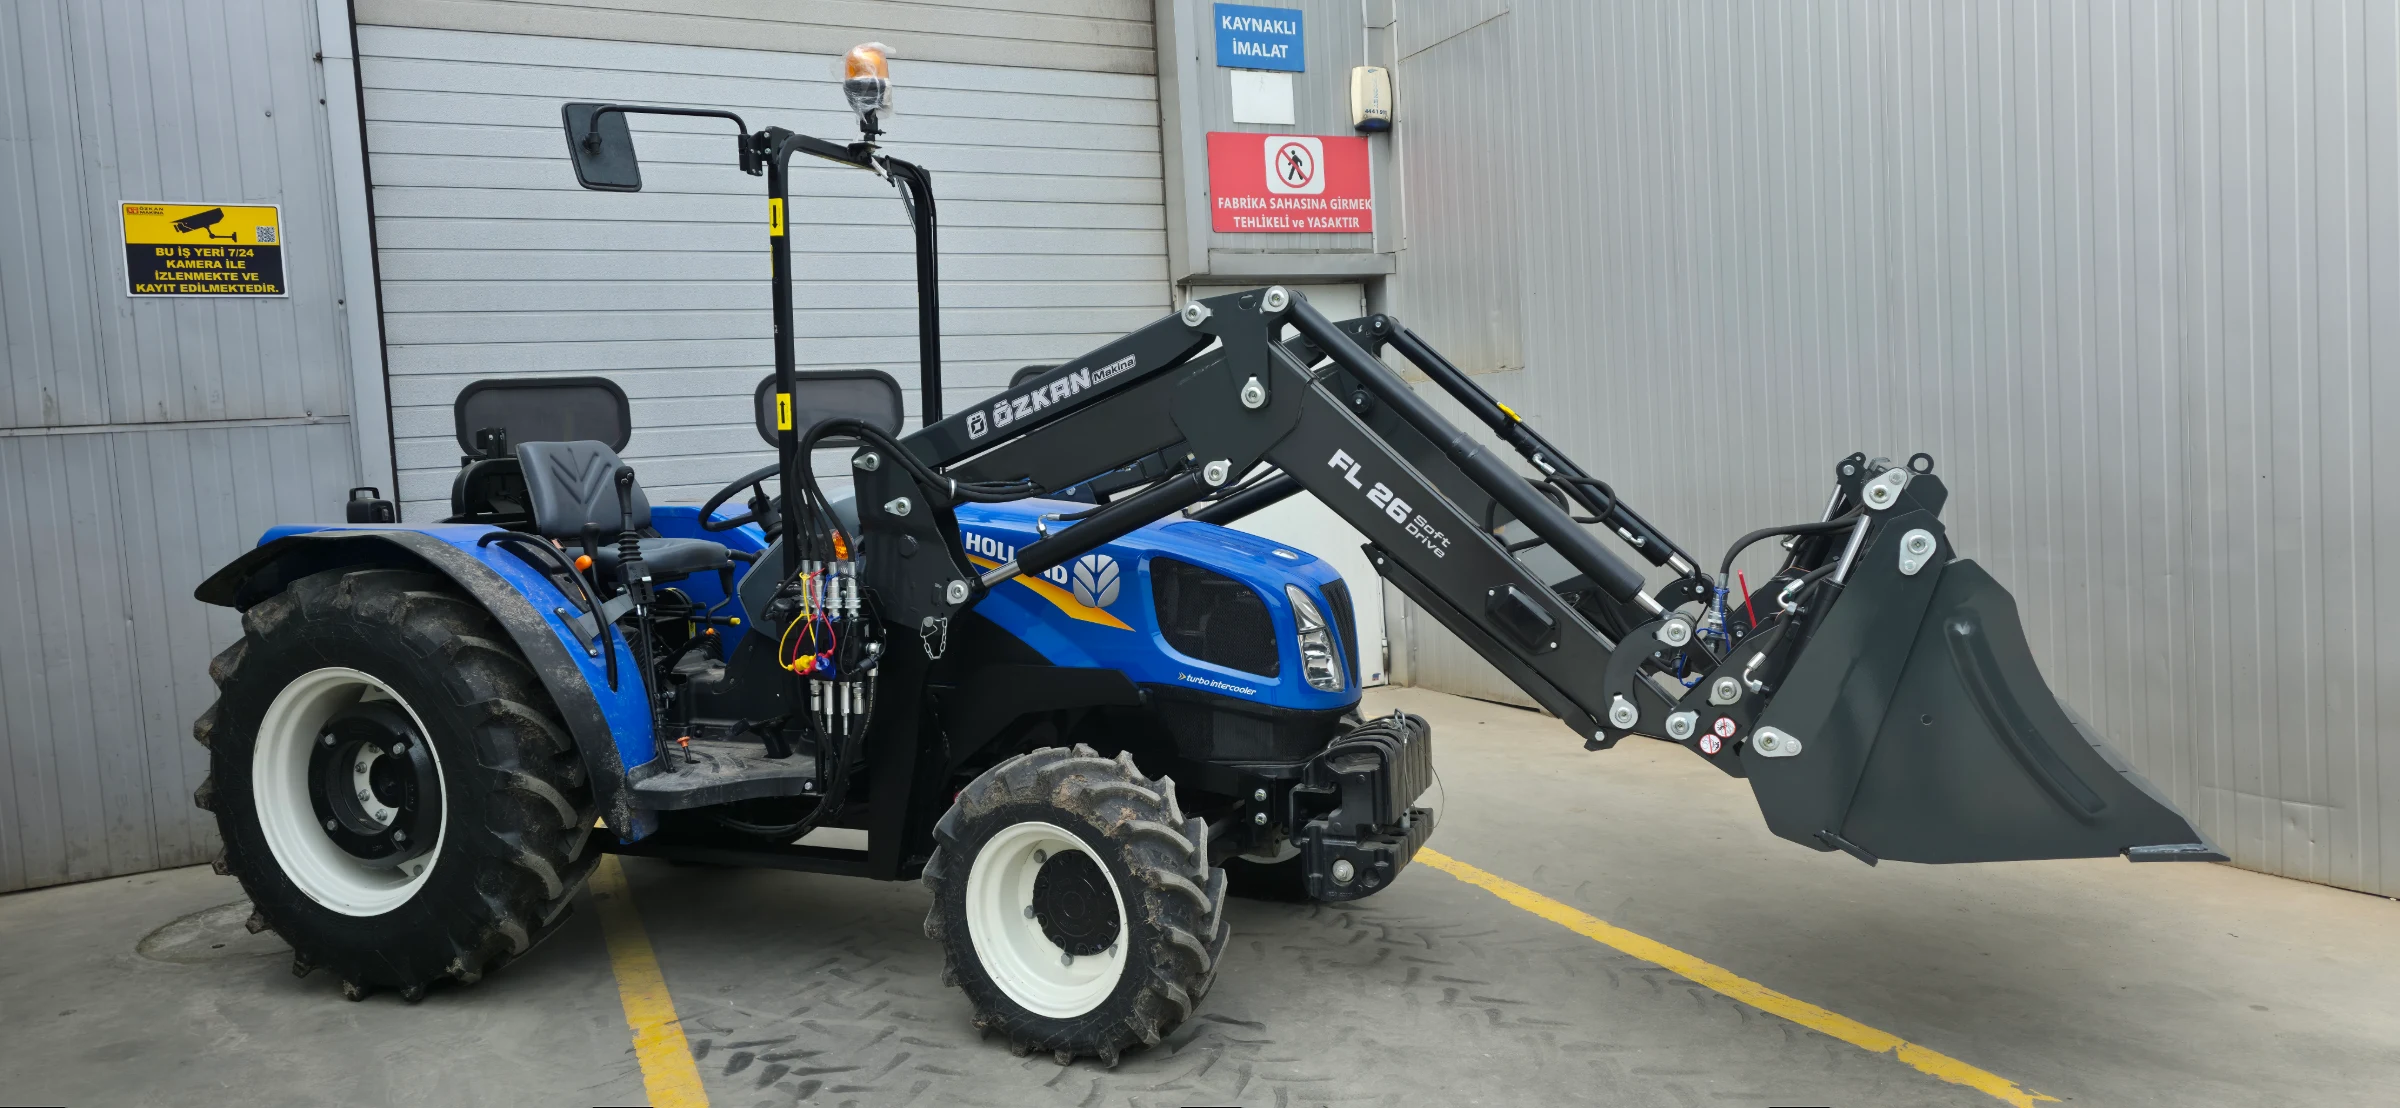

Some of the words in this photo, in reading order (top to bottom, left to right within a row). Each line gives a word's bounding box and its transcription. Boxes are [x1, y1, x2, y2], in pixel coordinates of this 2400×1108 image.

[1222, 15, 1296, 35] KAYNAKLI
[1232, 37, 1288, 59] İMALAT
[1218, 195, 1267, 209] FABRİKA
[1270, 197, 1327, 210] SAHASINA
[1330, 196, 1372, 210] GİRMEK
[1234, 214, 1290, 228] TEHLİKELİ
[1292, 219, 1305, 228] ve
[1307, 217, 1360, 228] YASAKTIR
[155, 247, 174, 257] BU
[178, 246, 191, 259] İŞ
[195, 246, 224, 257] YERİ
[228, 248, 254, 258] 7/24
[166, 259, 222, 269] KAMERA
[226, 258, 246, 269] İLE
[155, 270, 239, 281] İZLENMEKTE
[242, 272, 259, 281] VE
[136, 283, 176, 293] KAYIT
[180, 282, 279, 293] EDİLMEKTEDİR.
[993, 366, 1092, 428] ÖZKAN
[1093, 356, 1135, 383] Makina
[1327, 448, 1363, 490] FL
[1365, 481, 1413, 524] 26
[1413, 514, 1451, 548] Soft
[1405, 522, 1445, 559] Drive
[965, 531, 1068, 585] HOLLD
[1186, 674, 1210, 686] turbo
[1210, 680, 1257, 695] intercooler
